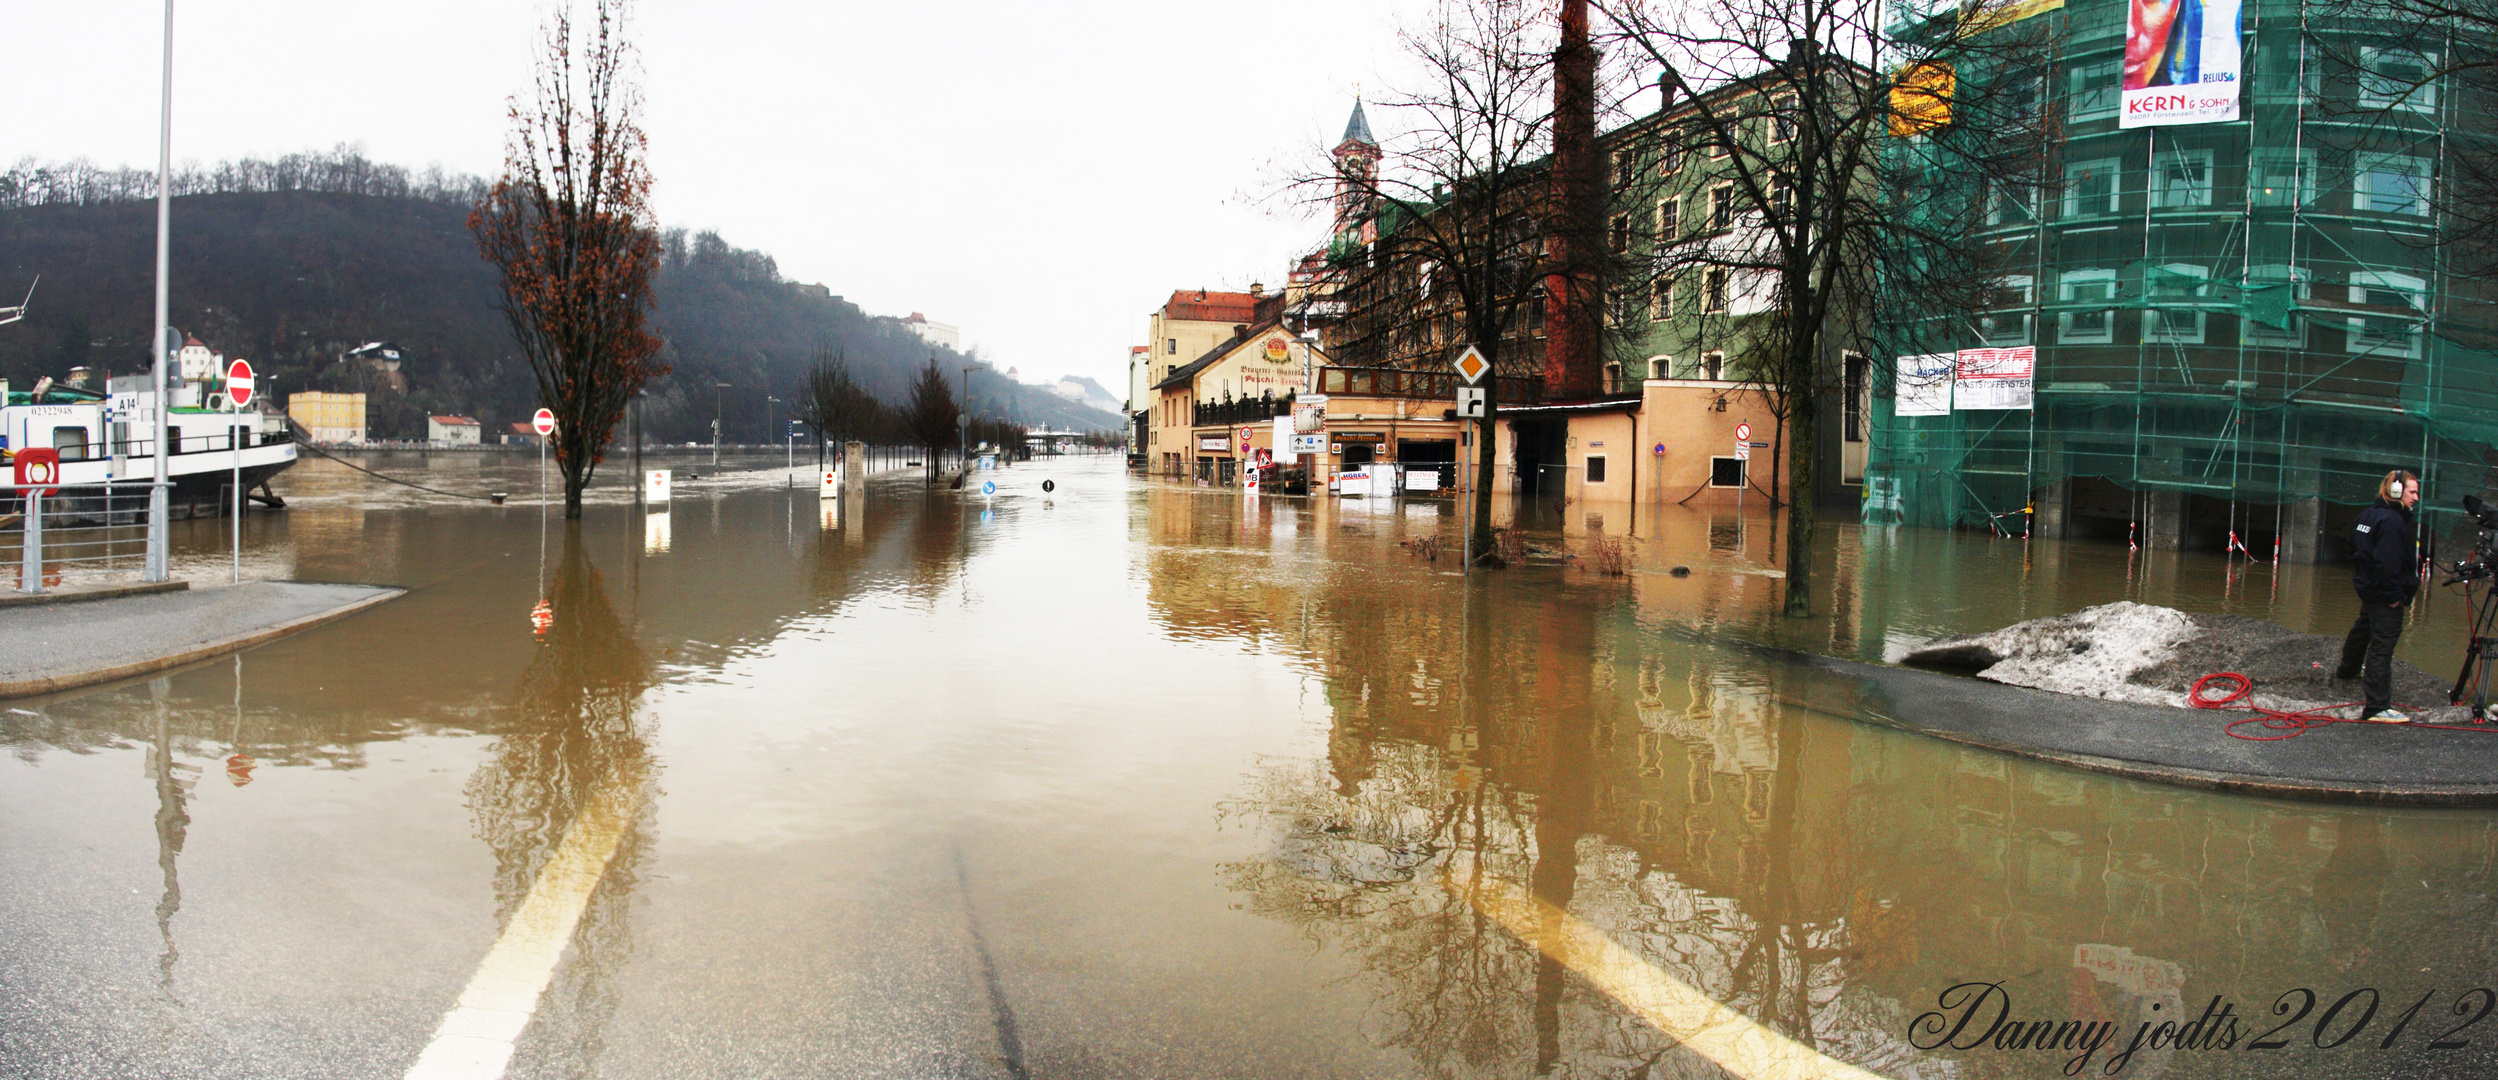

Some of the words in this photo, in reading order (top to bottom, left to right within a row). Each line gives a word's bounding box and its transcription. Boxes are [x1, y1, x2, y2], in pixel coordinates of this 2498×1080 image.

[2203, 72, 2229, 84] RELIUS
[2129, 95, 2185, 114] KERN
[2200, 97, 2230, 108] SOHN
[1245, 375, 1274, 384] Peschl
[119, 400, 125, 410] A
[128, 399, 135, 409] 14
[31, 406, 73, 416] 02322948
[1245, 474, 1258, 482] MB
